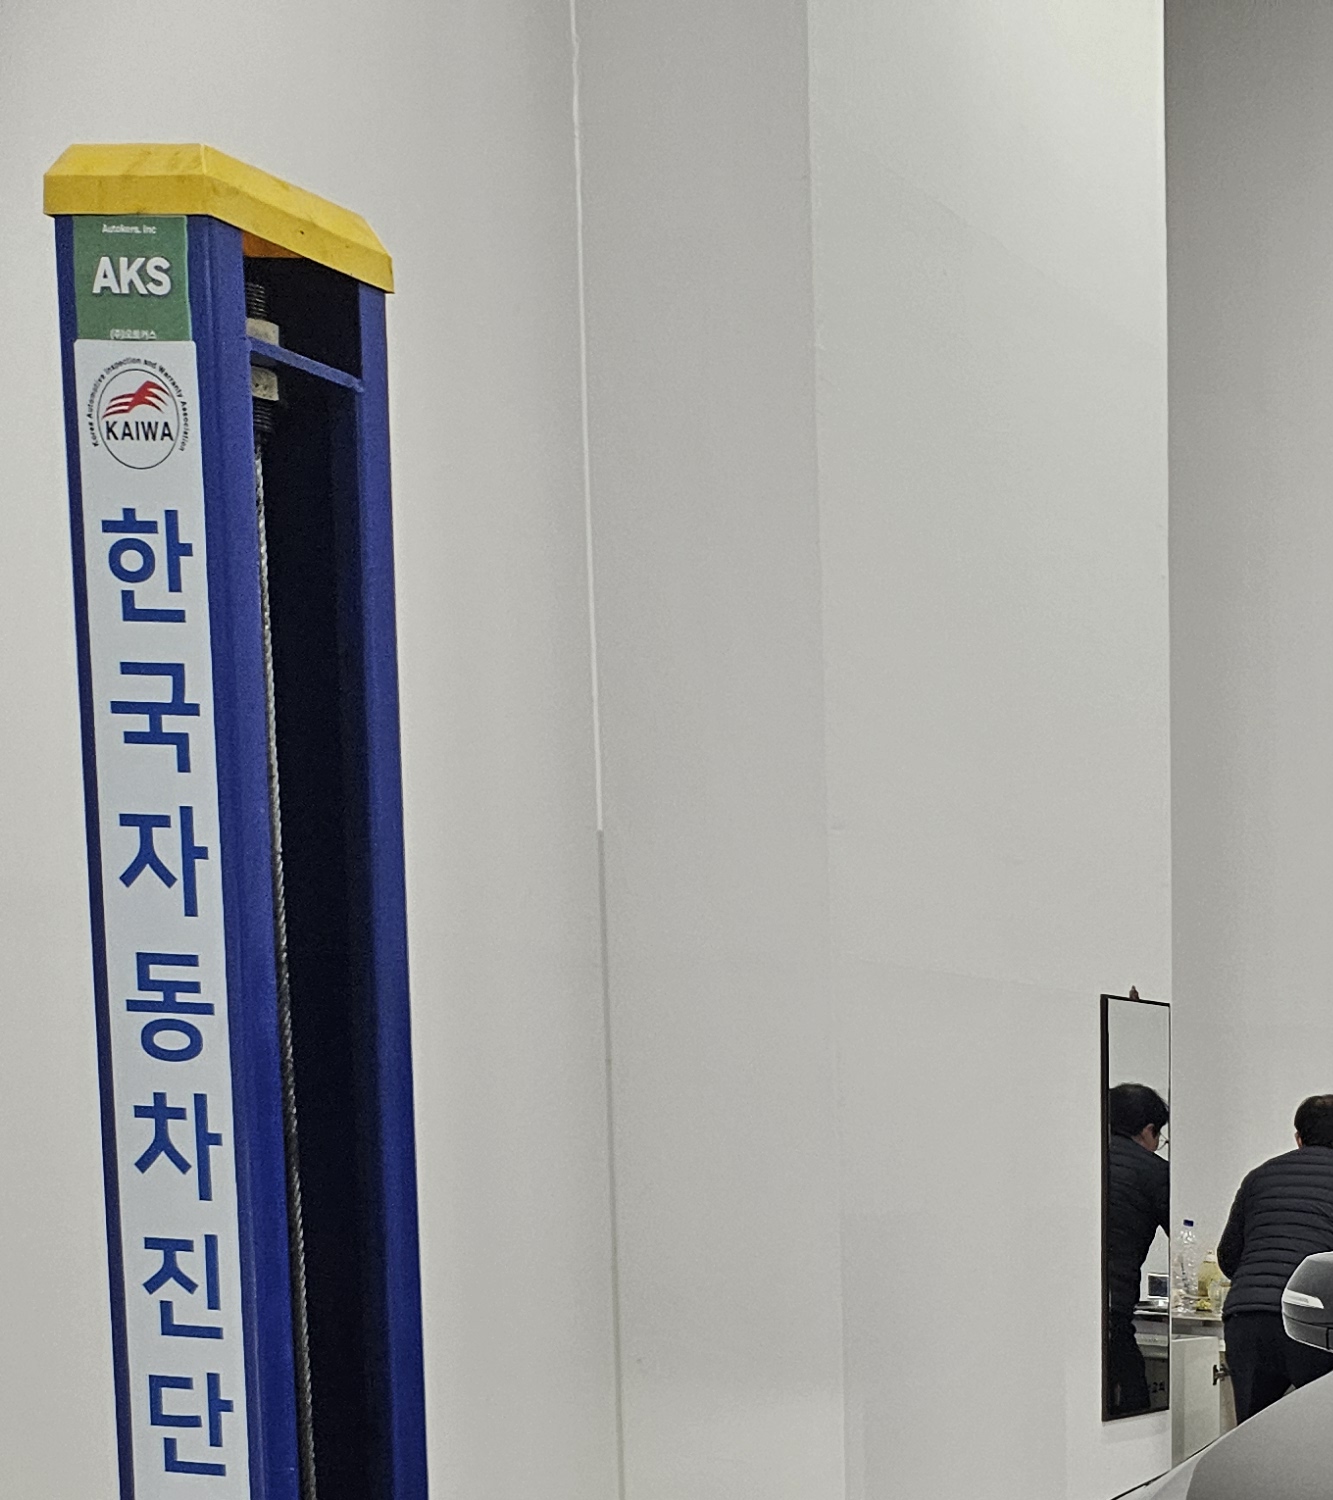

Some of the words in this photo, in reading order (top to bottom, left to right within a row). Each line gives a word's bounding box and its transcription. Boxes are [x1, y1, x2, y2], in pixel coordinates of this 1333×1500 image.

[92, 256, 172, 296] AKS
[158, 365, 183, 398] Warranty
[105, 420, 174, 441] KAIWA
